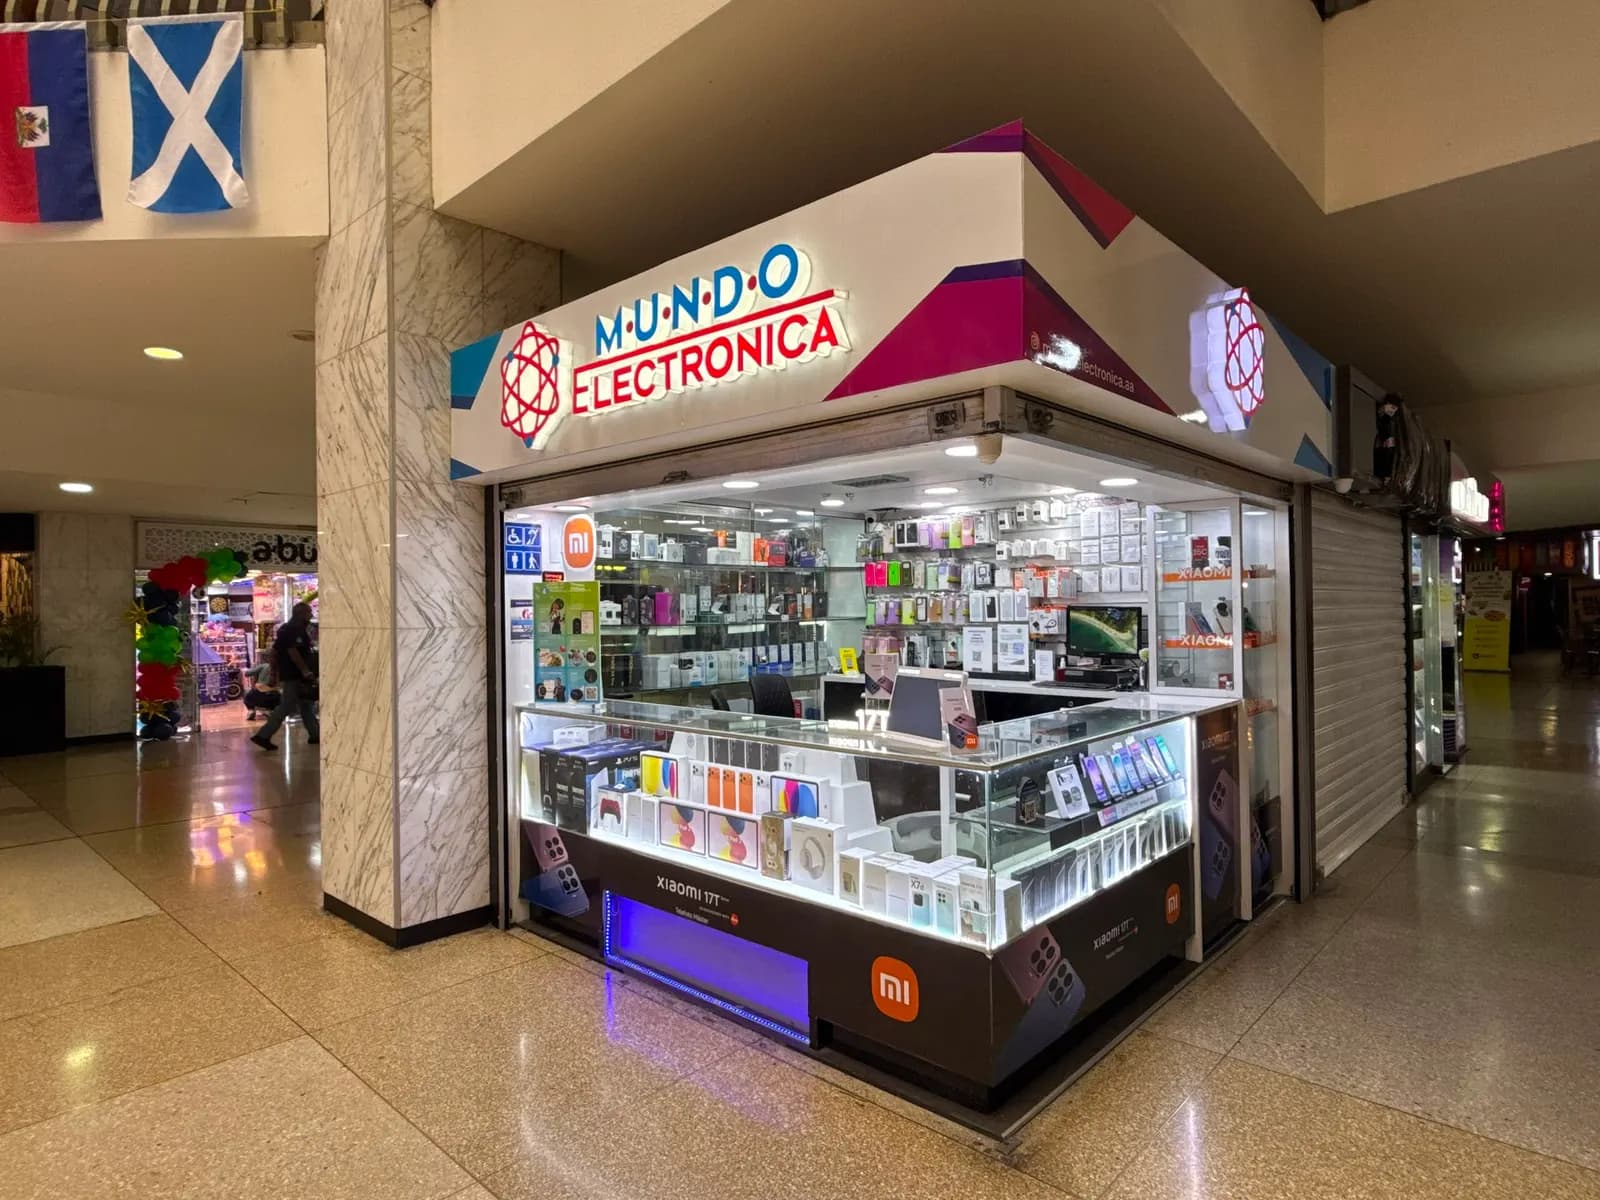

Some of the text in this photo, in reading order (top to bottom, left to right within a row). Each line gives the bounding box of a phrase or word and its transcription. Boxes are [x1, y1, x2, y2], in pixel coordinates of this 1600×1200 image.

[572, 306, 840, 415] ELECTRONICA
[1178, 565, 1231, 579] XIAOMI
[855, 709, 890, 731] 17T
[704, 891, 720, 907] 17T
